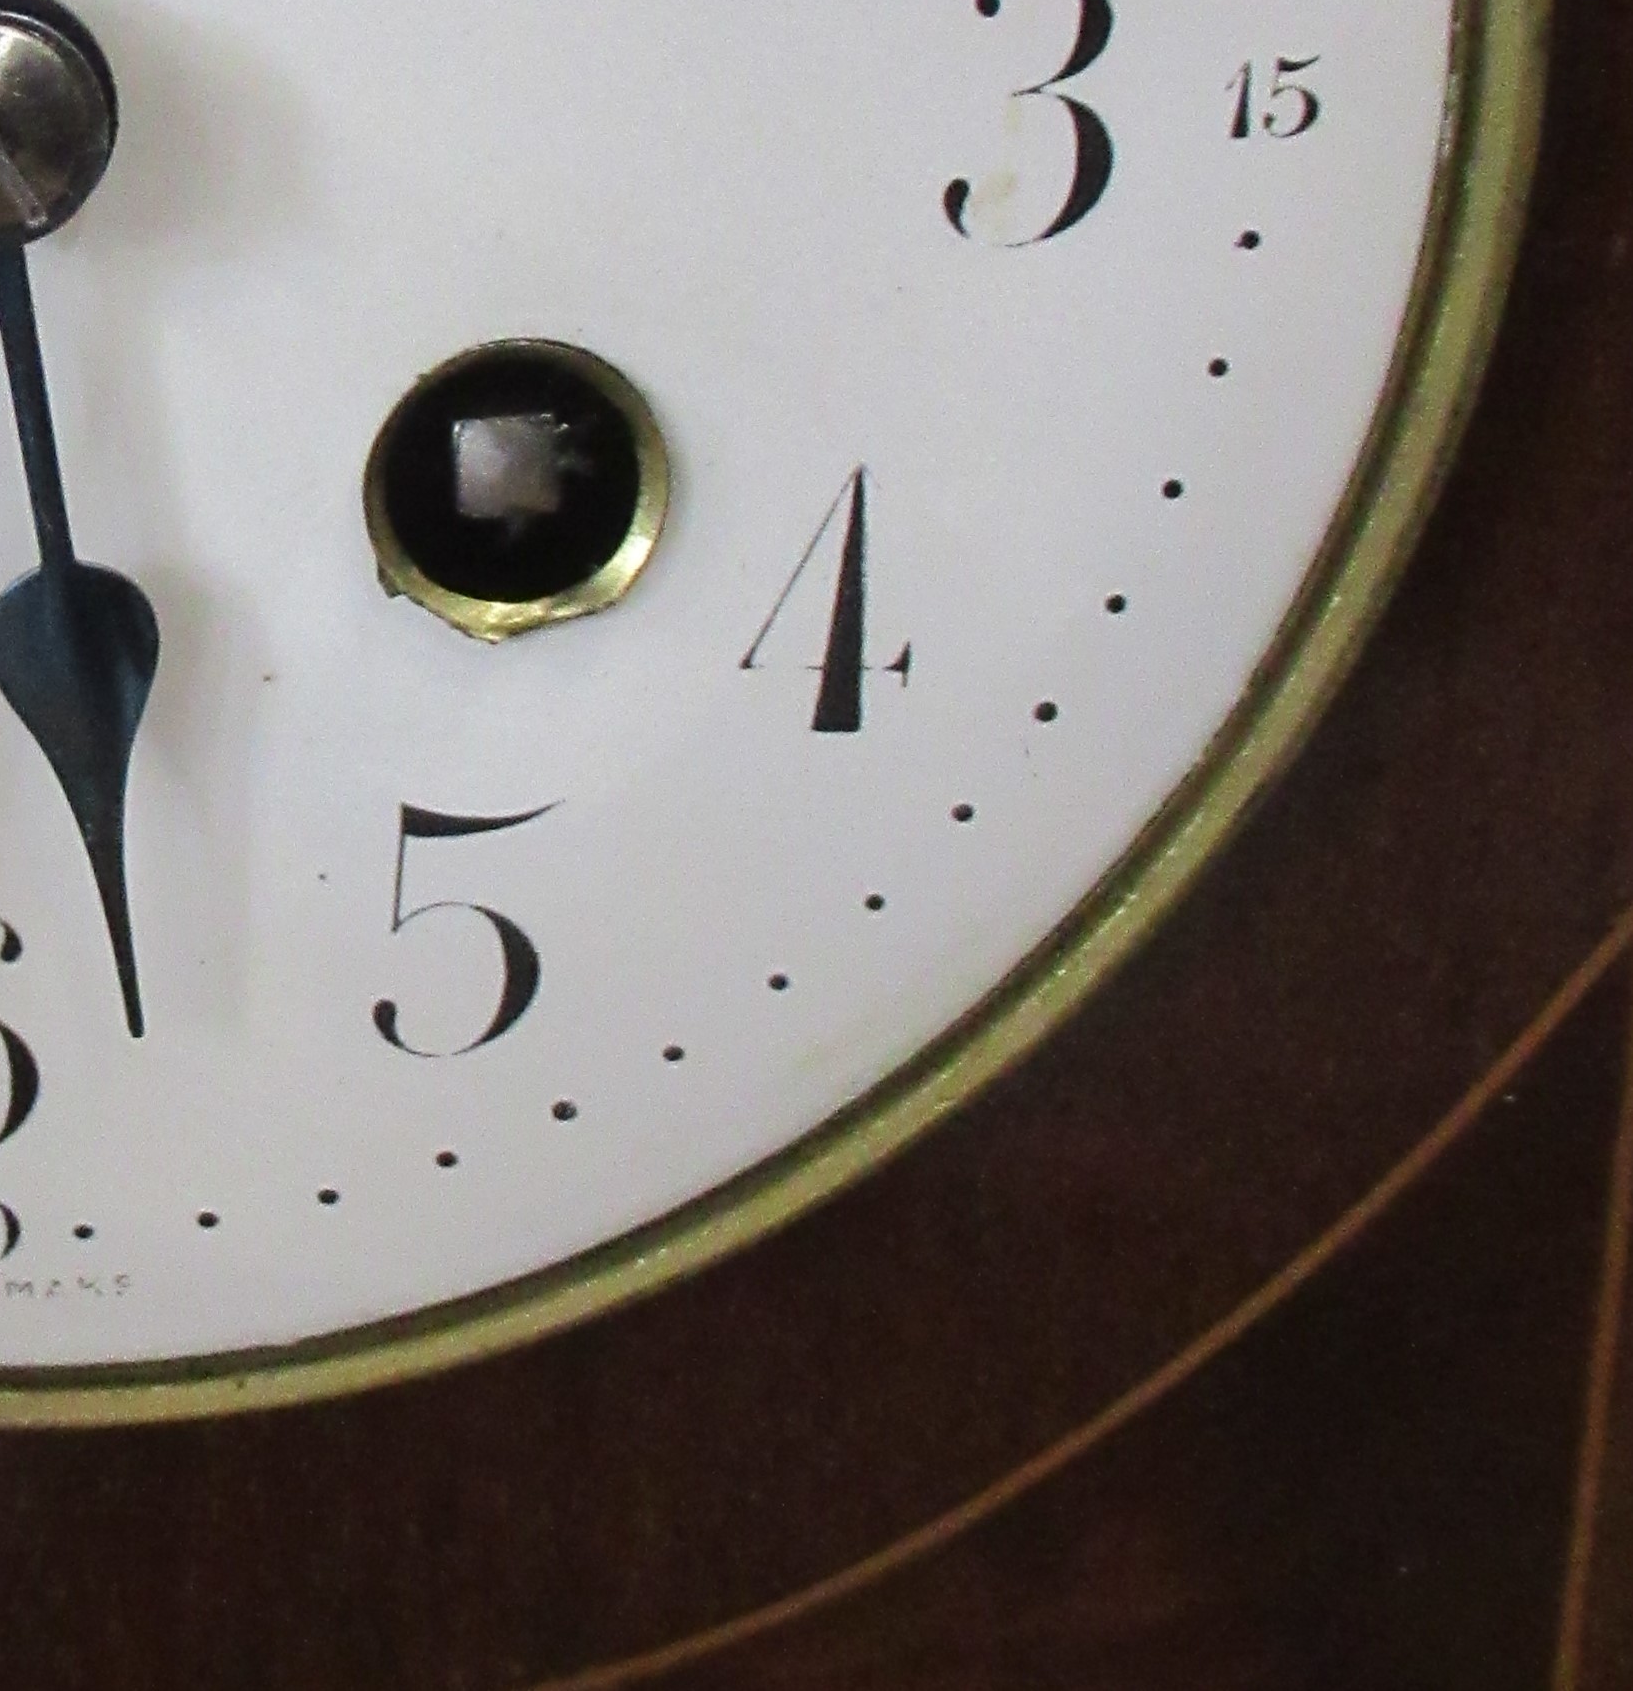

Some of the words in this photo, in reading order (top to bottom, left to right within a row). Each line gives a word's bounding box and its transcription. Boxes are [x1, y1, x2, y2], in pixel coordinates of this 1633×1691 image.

[1227, 56, 1323, 141] 15
[739, 466, 912, 733] 4
[372, 803, 560, 1059] 5
